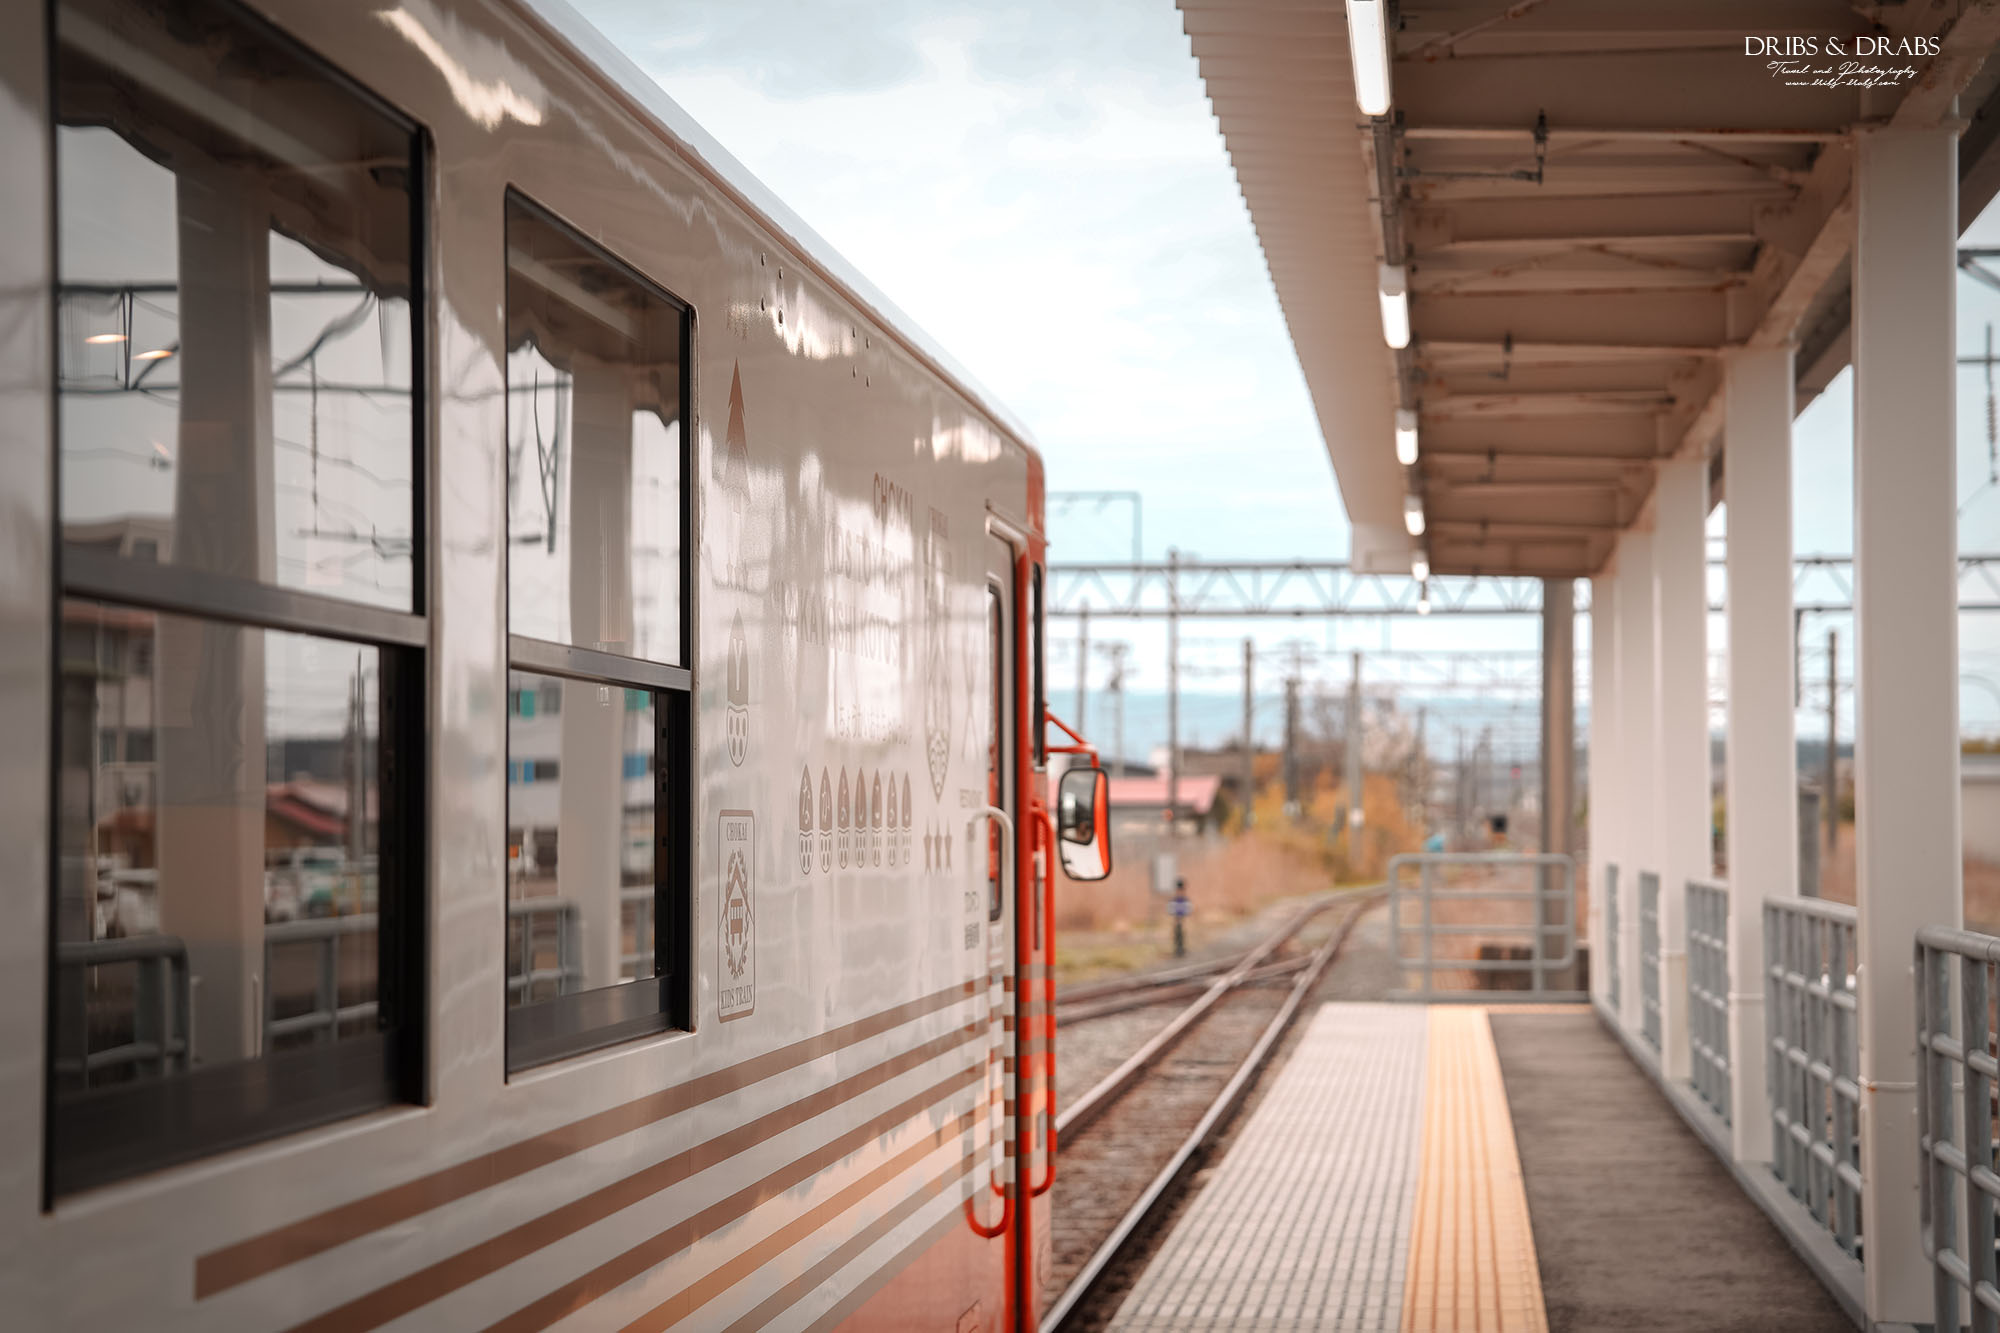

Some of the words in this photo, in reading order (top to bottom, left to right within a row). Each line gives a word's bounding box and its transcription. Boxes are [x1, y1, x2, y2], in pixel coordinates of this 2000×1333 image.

[726, 822, 748, 841] CHOKAI
[720, 988, 735, 1010] KIDS
[735, 983, 753, 1007] TRAIN
